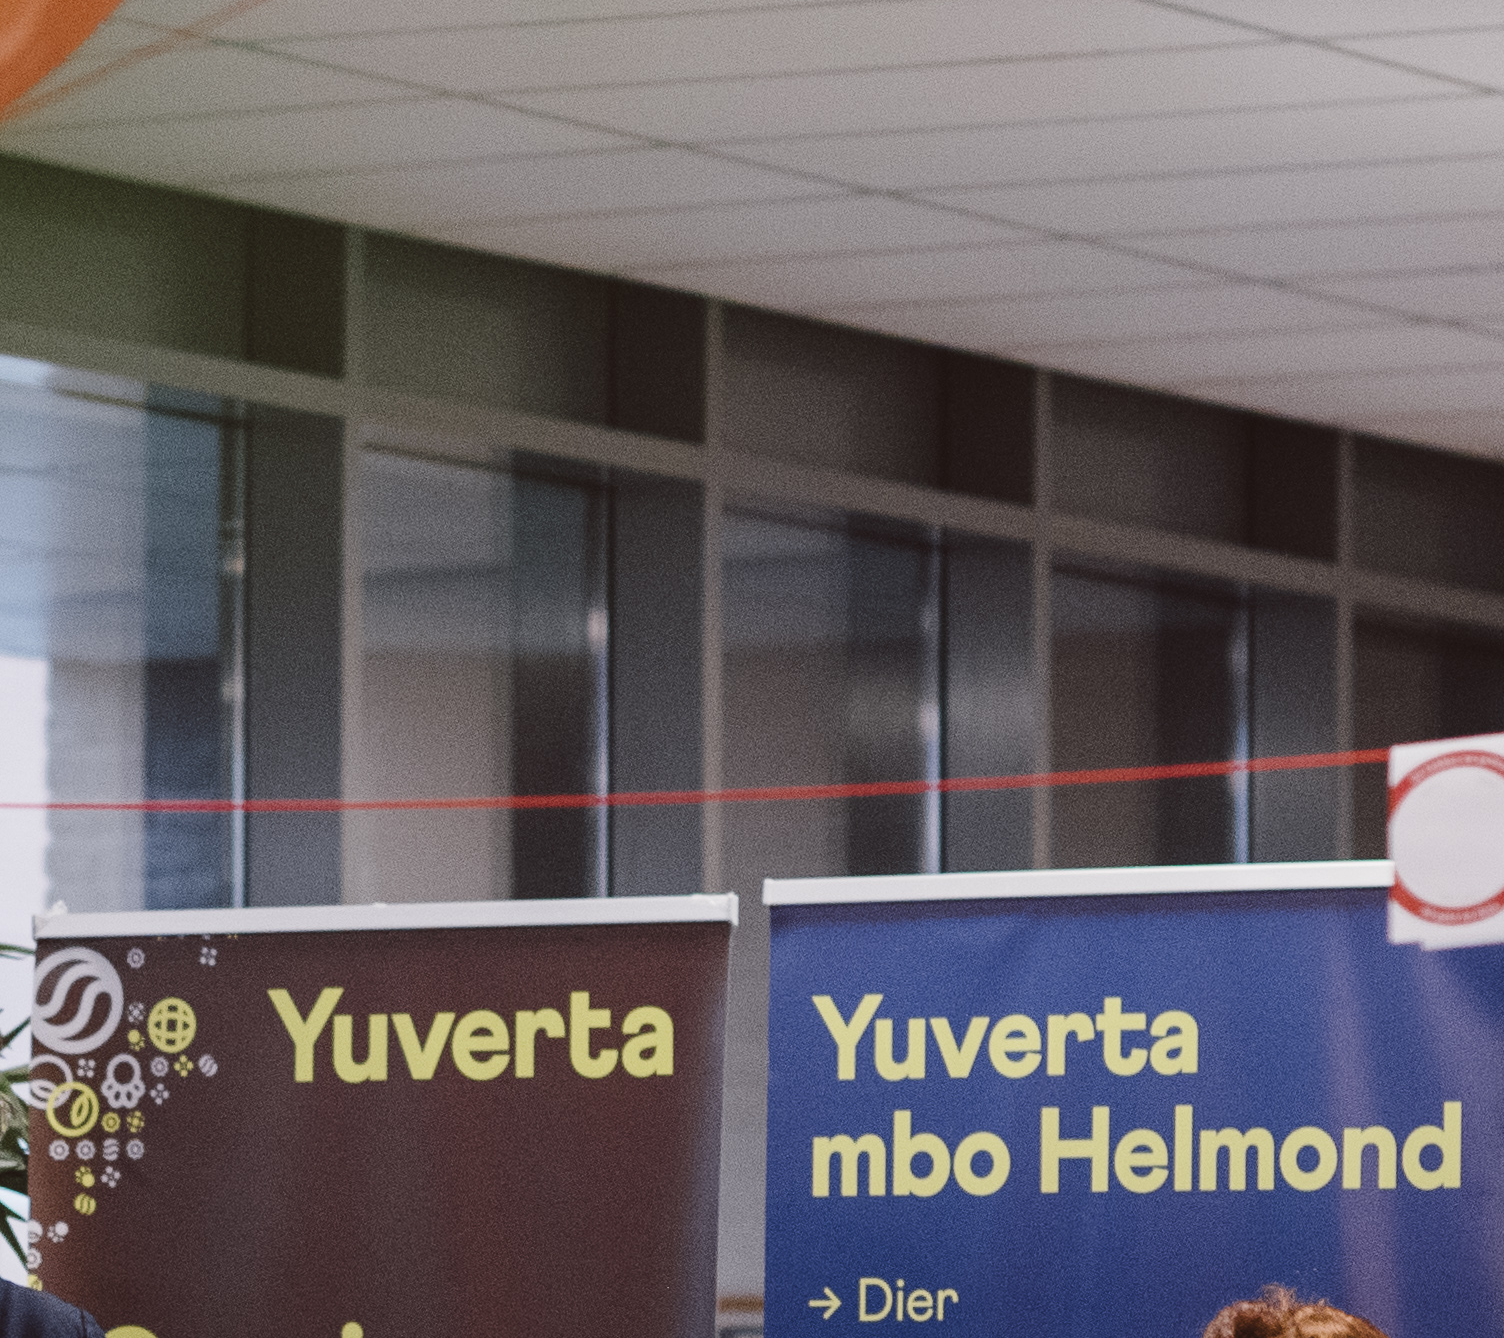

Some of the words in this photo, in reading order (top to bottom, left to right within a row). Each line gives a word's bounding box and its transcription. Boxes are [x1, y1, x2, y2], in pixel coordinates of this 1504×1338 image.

[267, 987, 675, 1083] Yuverta
[812, 994, 1198, 1081] Yuverta
[812, 1109, 1010, 1198] mbo
[1041, 1101, 1463, 1193] Helmond
[858, 1278, 958, 1323] Dier
